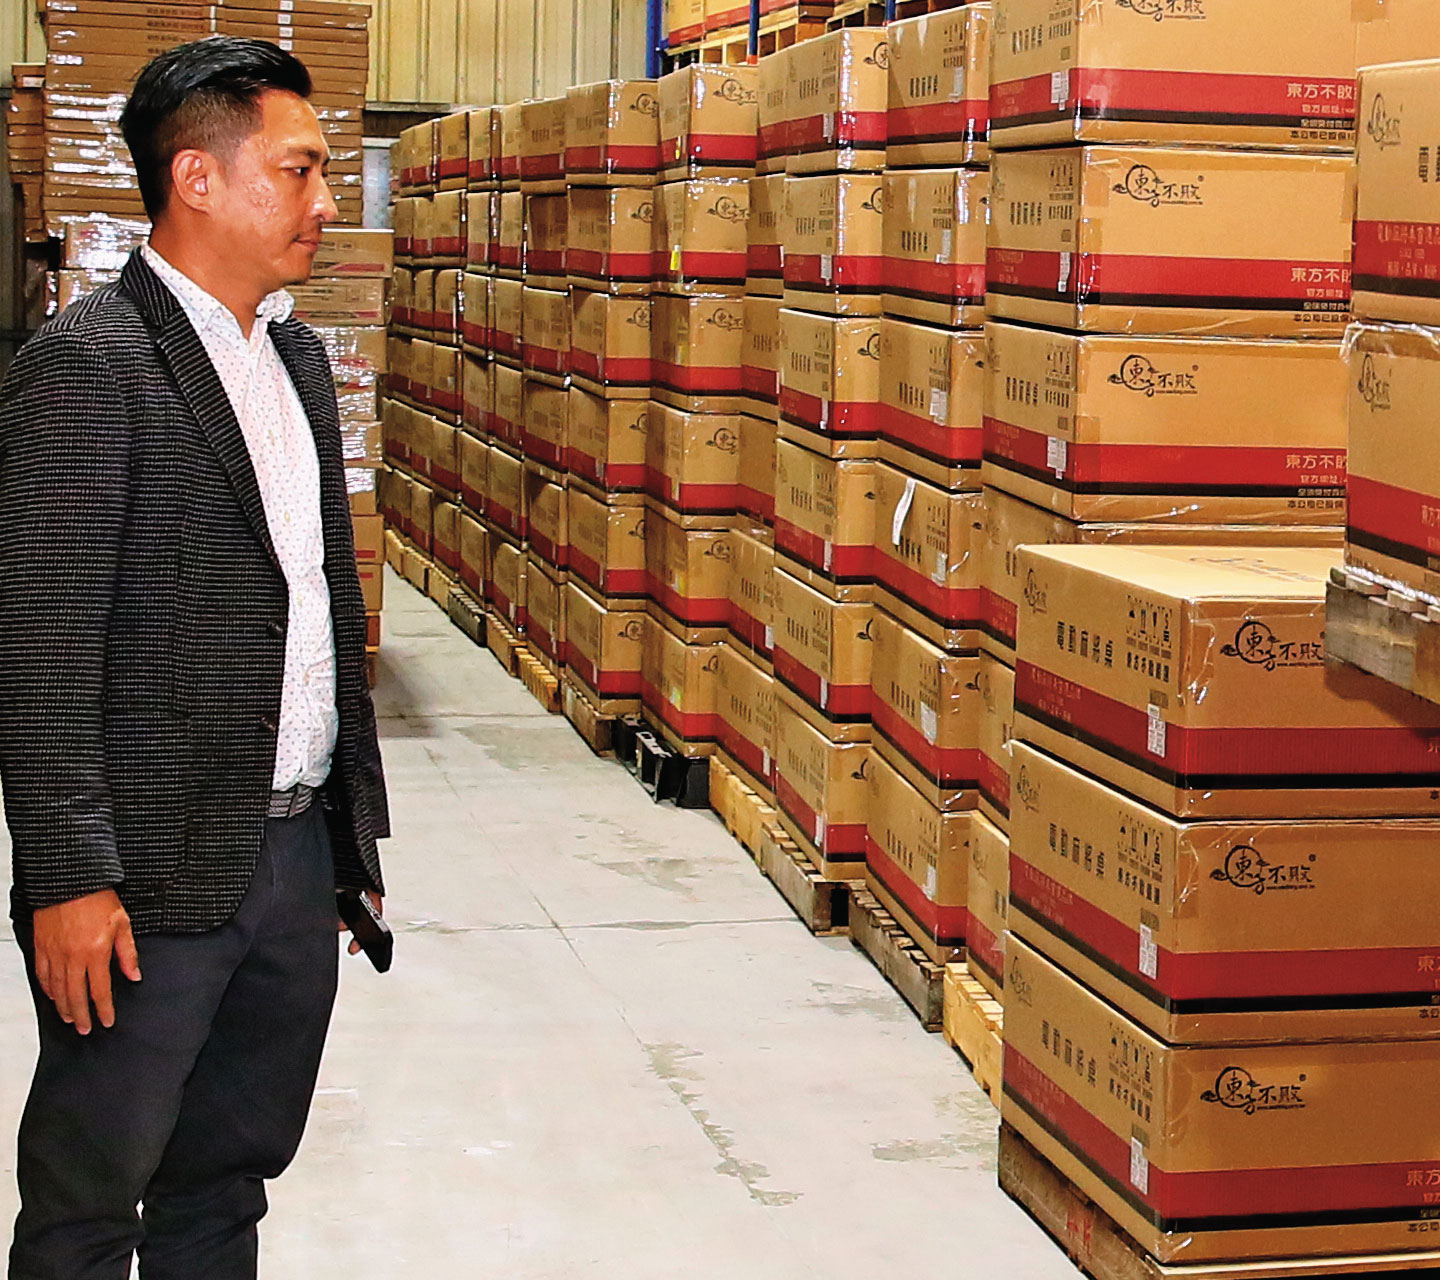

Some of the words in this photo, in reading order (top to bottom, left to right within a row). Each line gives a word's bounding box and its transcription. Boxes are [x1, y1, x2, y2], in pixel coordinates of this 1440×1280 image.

[1235, 848, 1313, 895] 東方不敗
[1225, 1070, 1303, 1115] 東方不敗
